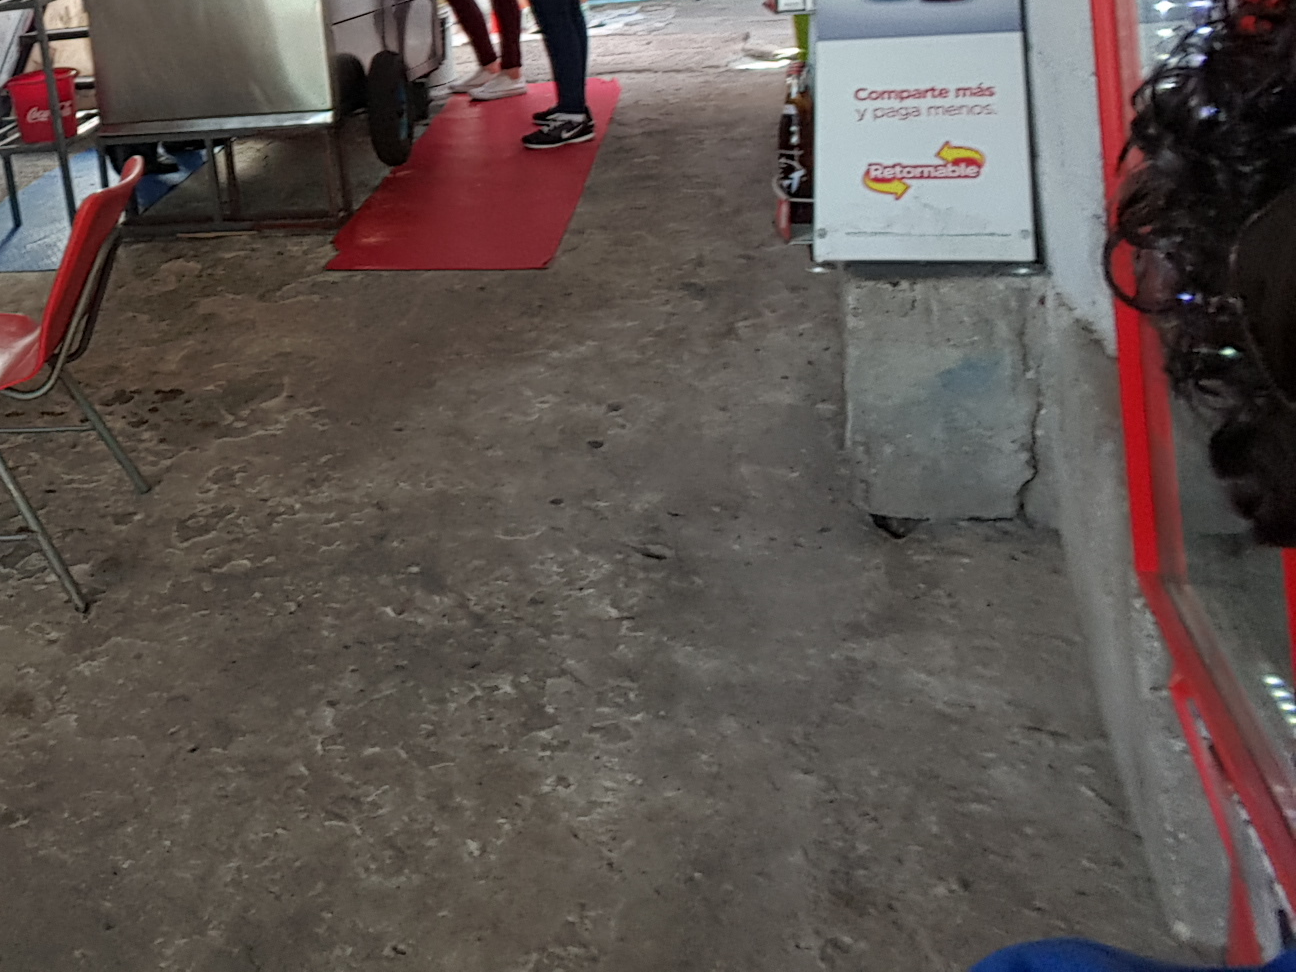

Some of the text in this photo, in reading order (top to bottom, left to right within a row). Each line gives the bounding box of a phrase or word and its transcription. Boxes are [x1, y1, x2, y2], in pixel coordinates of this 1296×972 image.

[855, 82, 995, 102] Comparte más
[856, 102, 997, 122] y paga menos.
[869, 163, 979, 179] Retornable
